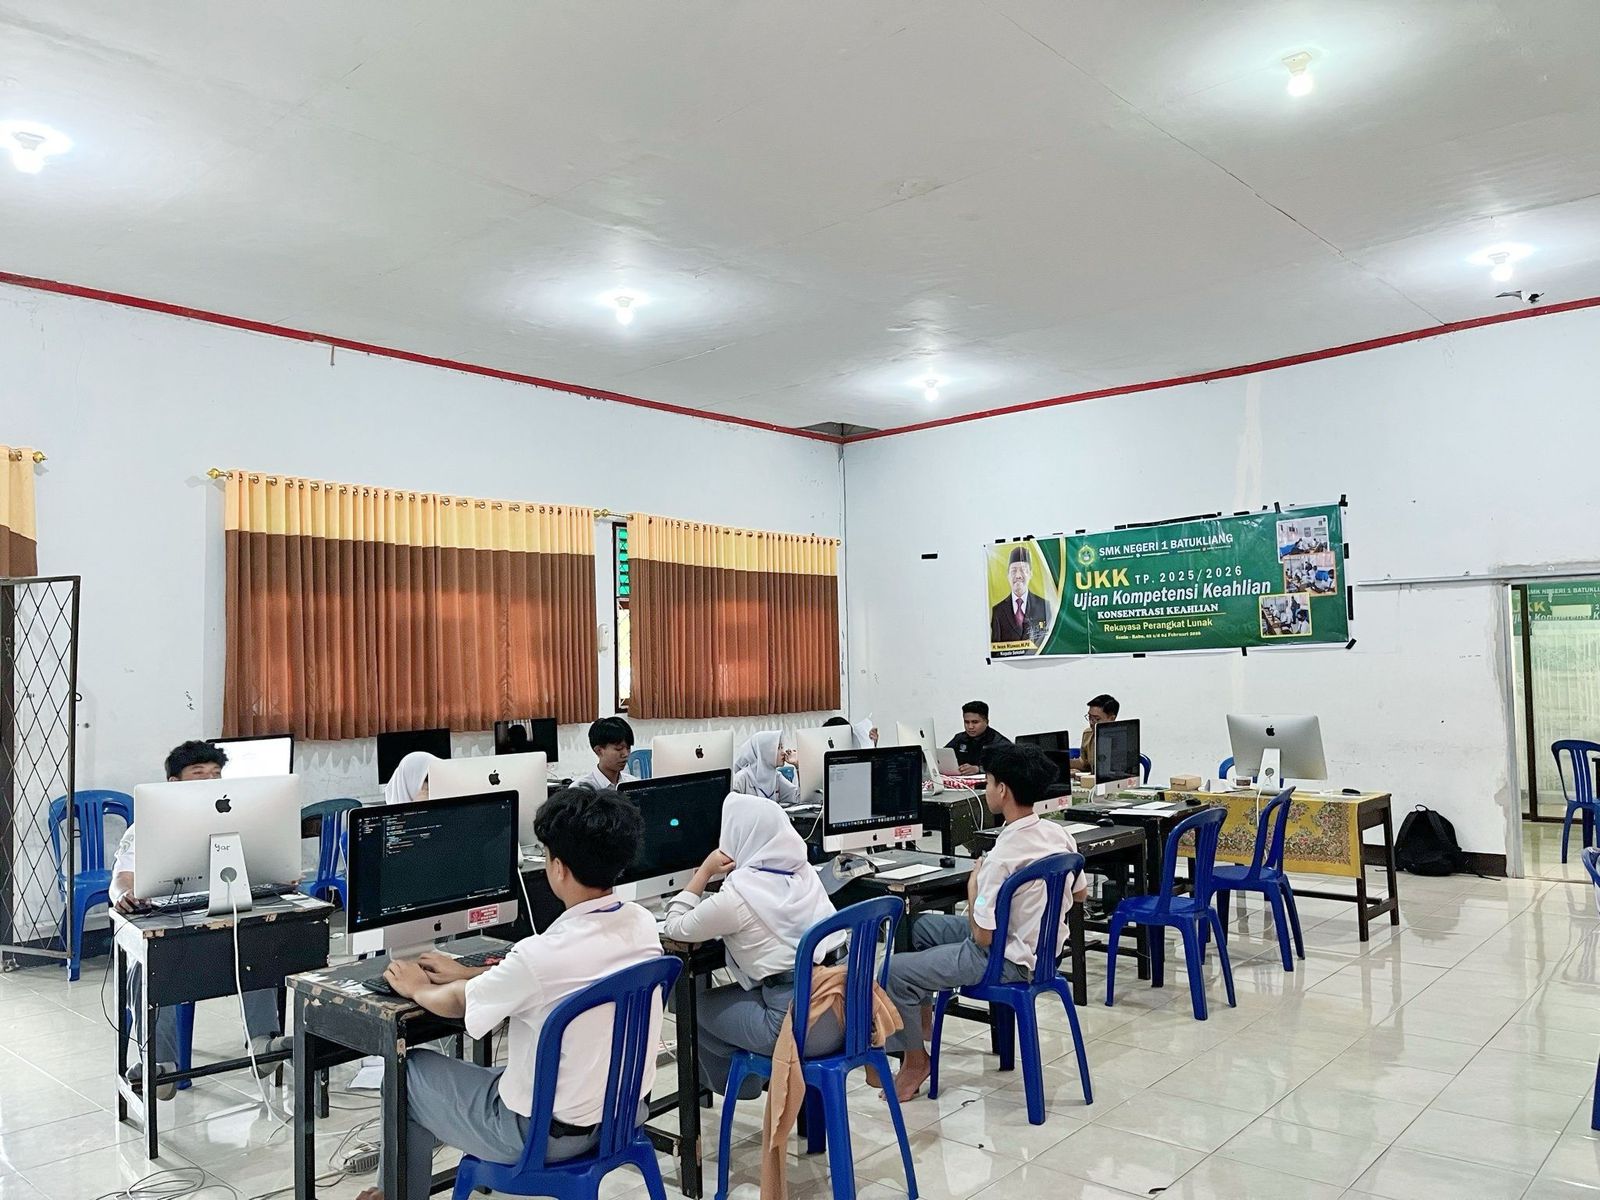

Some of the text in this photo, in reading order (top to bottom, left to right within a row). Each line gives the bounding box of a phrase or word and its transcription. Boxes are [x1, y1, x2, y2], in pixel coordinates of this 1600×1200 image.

[1099, 533, 1234, 557] SMK NEGERI 1 BATUKLIANG
[1075, 565, 1243, 590] UKK TP. 2025/2026
[1073, 579, 1271, 611] Ujian Kompetensi Keahlian
[1097, 603, 1219, 620] KONSENTRASI KEAHLIAN
[1103, 617, 1214, 633] Rekayasa Perangkat Lunak
